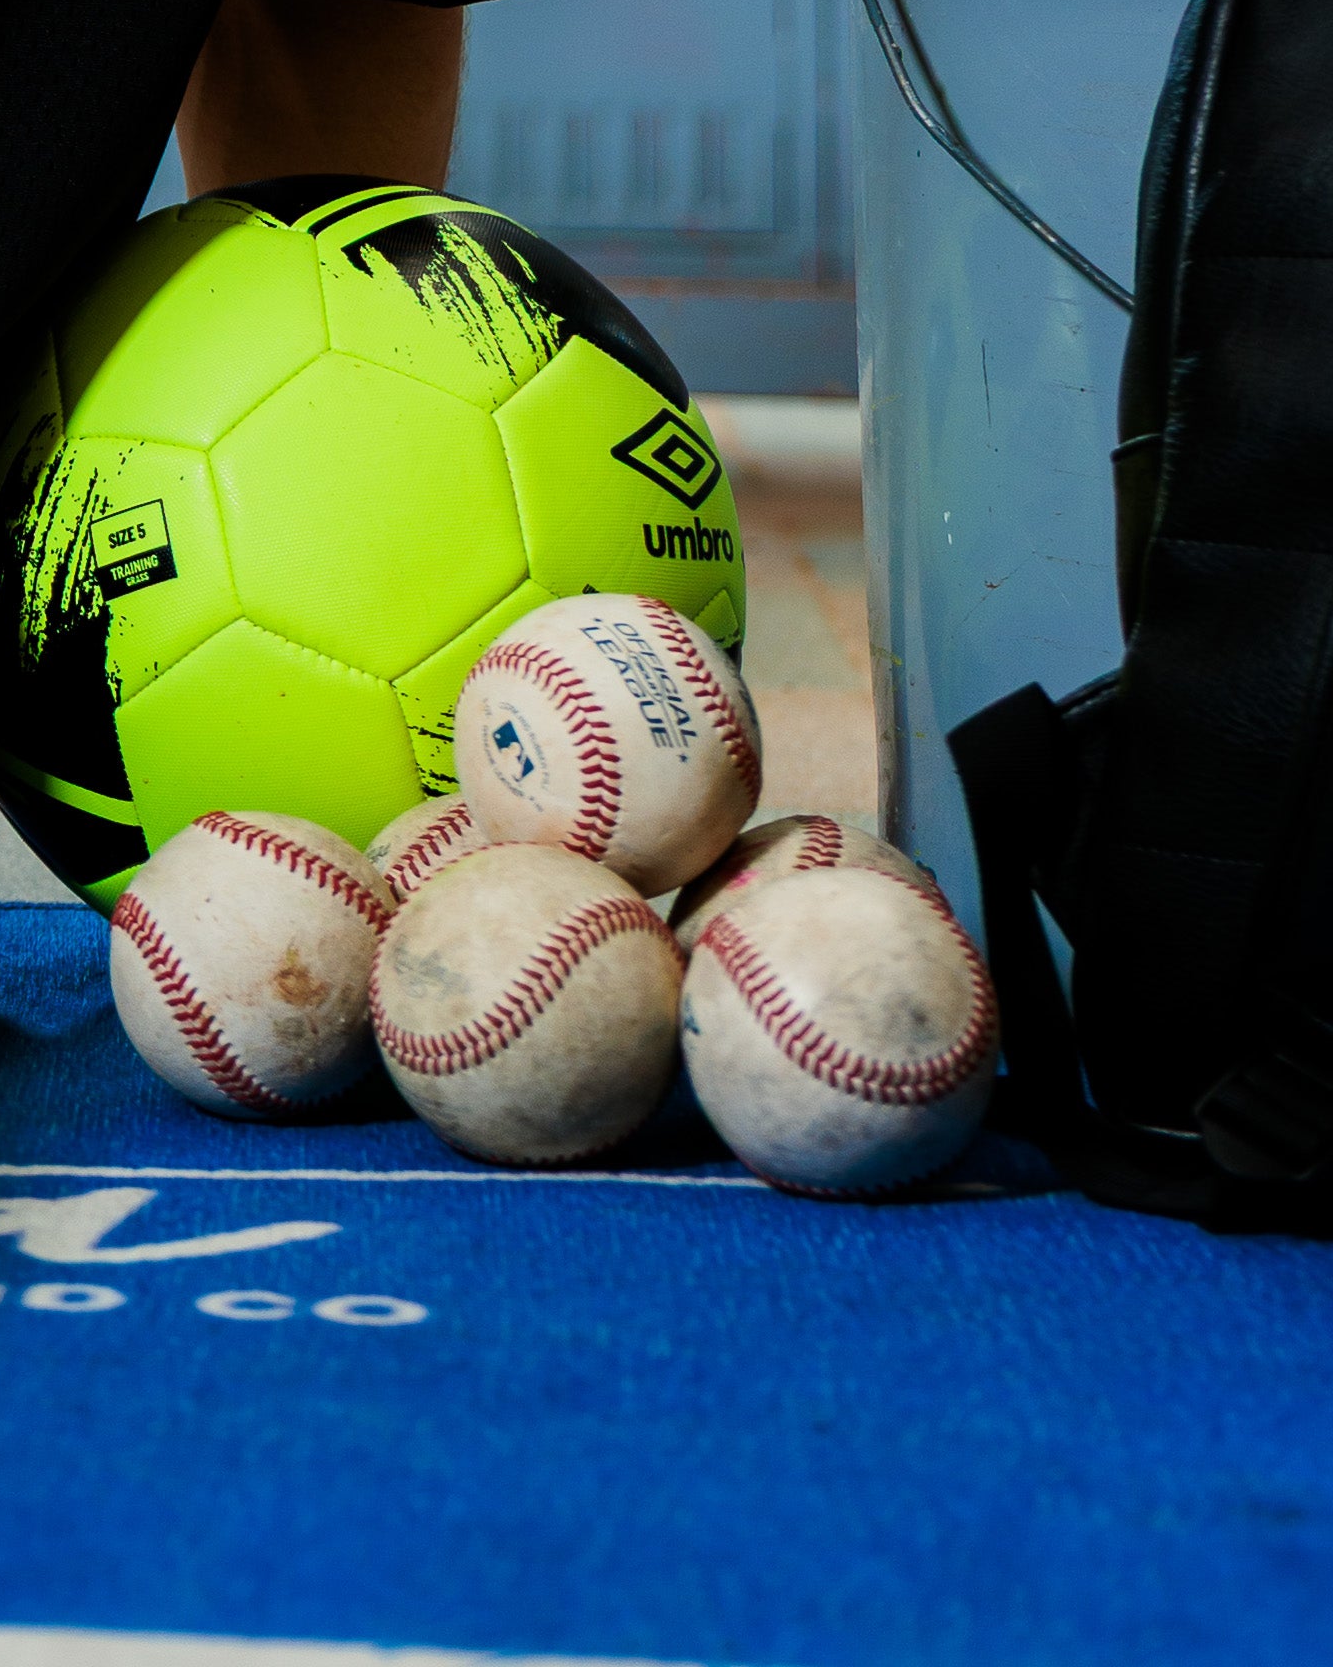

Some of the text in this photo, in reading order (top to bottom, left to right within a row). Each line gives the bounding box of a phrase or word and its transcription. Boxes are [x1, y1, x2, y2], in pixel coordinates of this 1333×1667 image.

[108, 522, 147, 549] SIZE 5
[642, 516, 734, 562] umbro
[110, 554, 159, 581] TRAINING
[125, 571, 150, 587] GRASS
[580, 626, 674, 750] LEAGUE
[614, 621, 697, 748] OFFICIAL
[193, 1287, 430, 1327] CO
